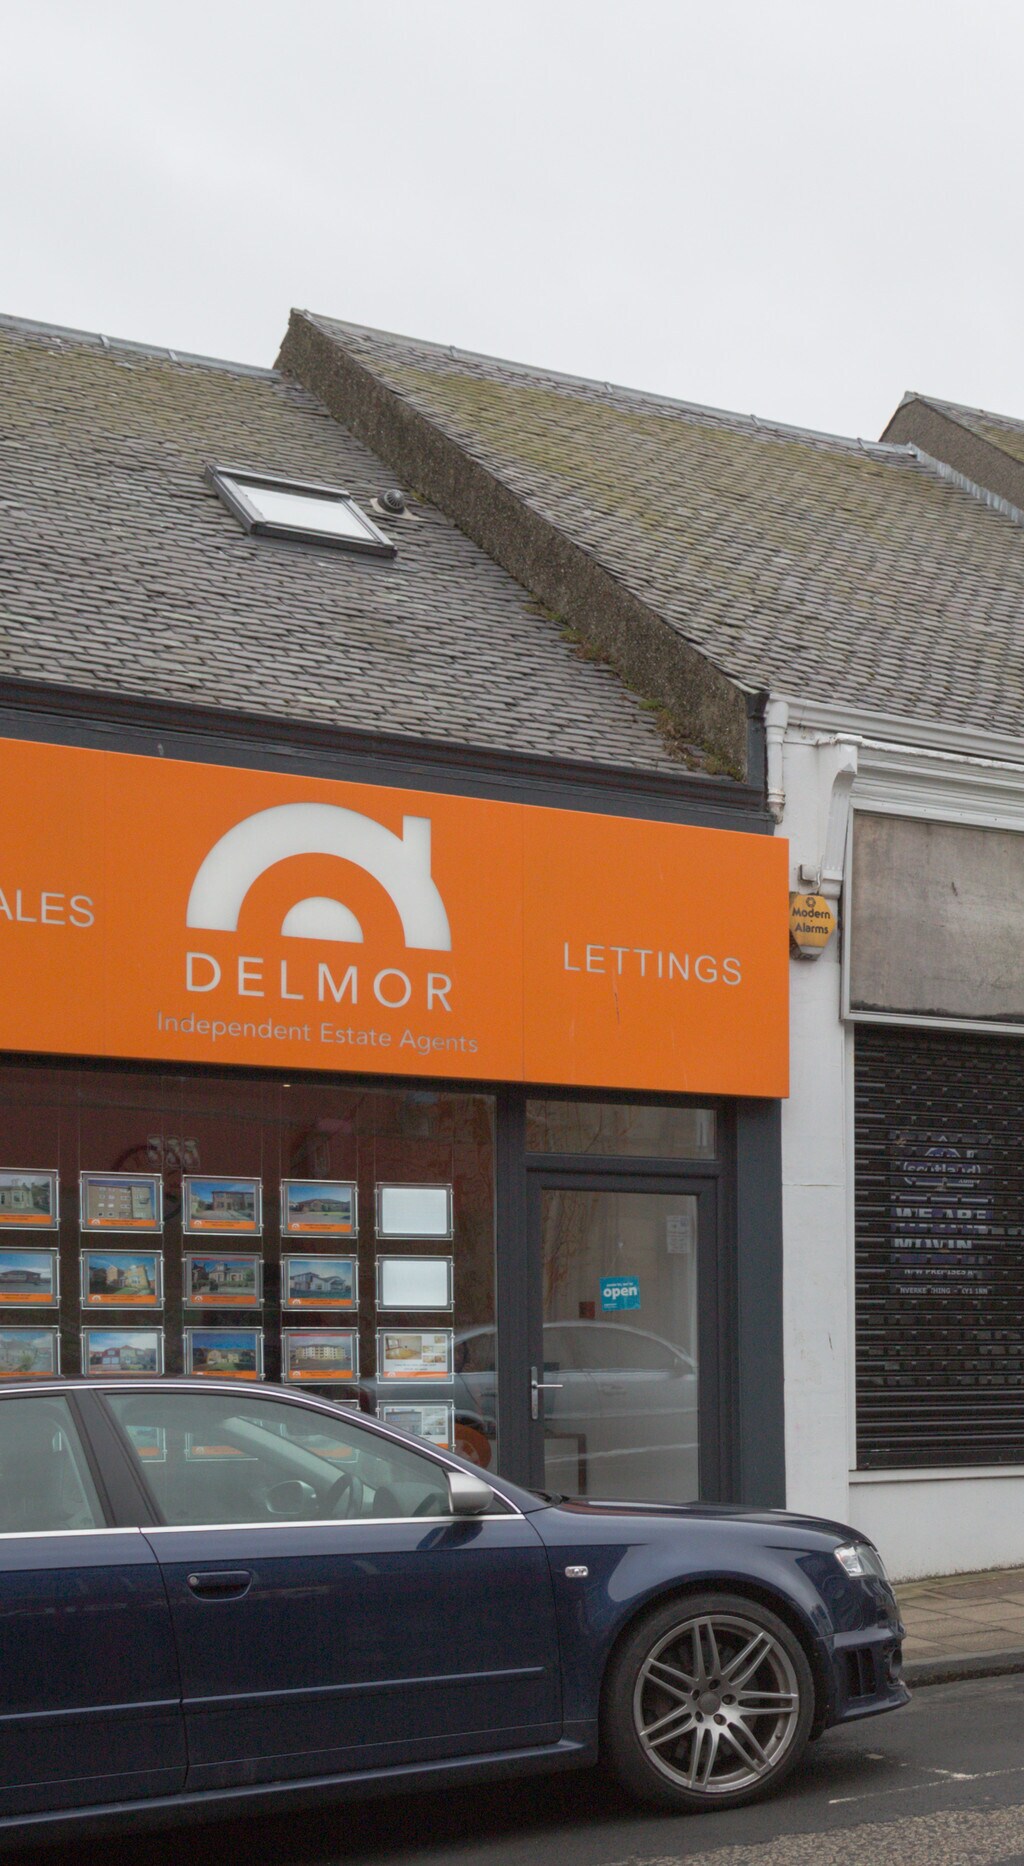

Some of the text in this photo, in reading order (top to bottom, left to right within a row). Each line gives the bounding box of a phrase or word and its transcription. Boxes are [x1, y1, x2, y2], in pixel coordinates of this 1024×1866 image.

[792, 907, 830, 919] Modern
[795, 922, 829, 934] Alarms
[563, 942, 743, 986] LETTINGS
[185, 951, 453, 1012] DELMOR
[156, 1011, 478, 1055] Independent Estate Agents
[603, 1286, 638, 1300] open
